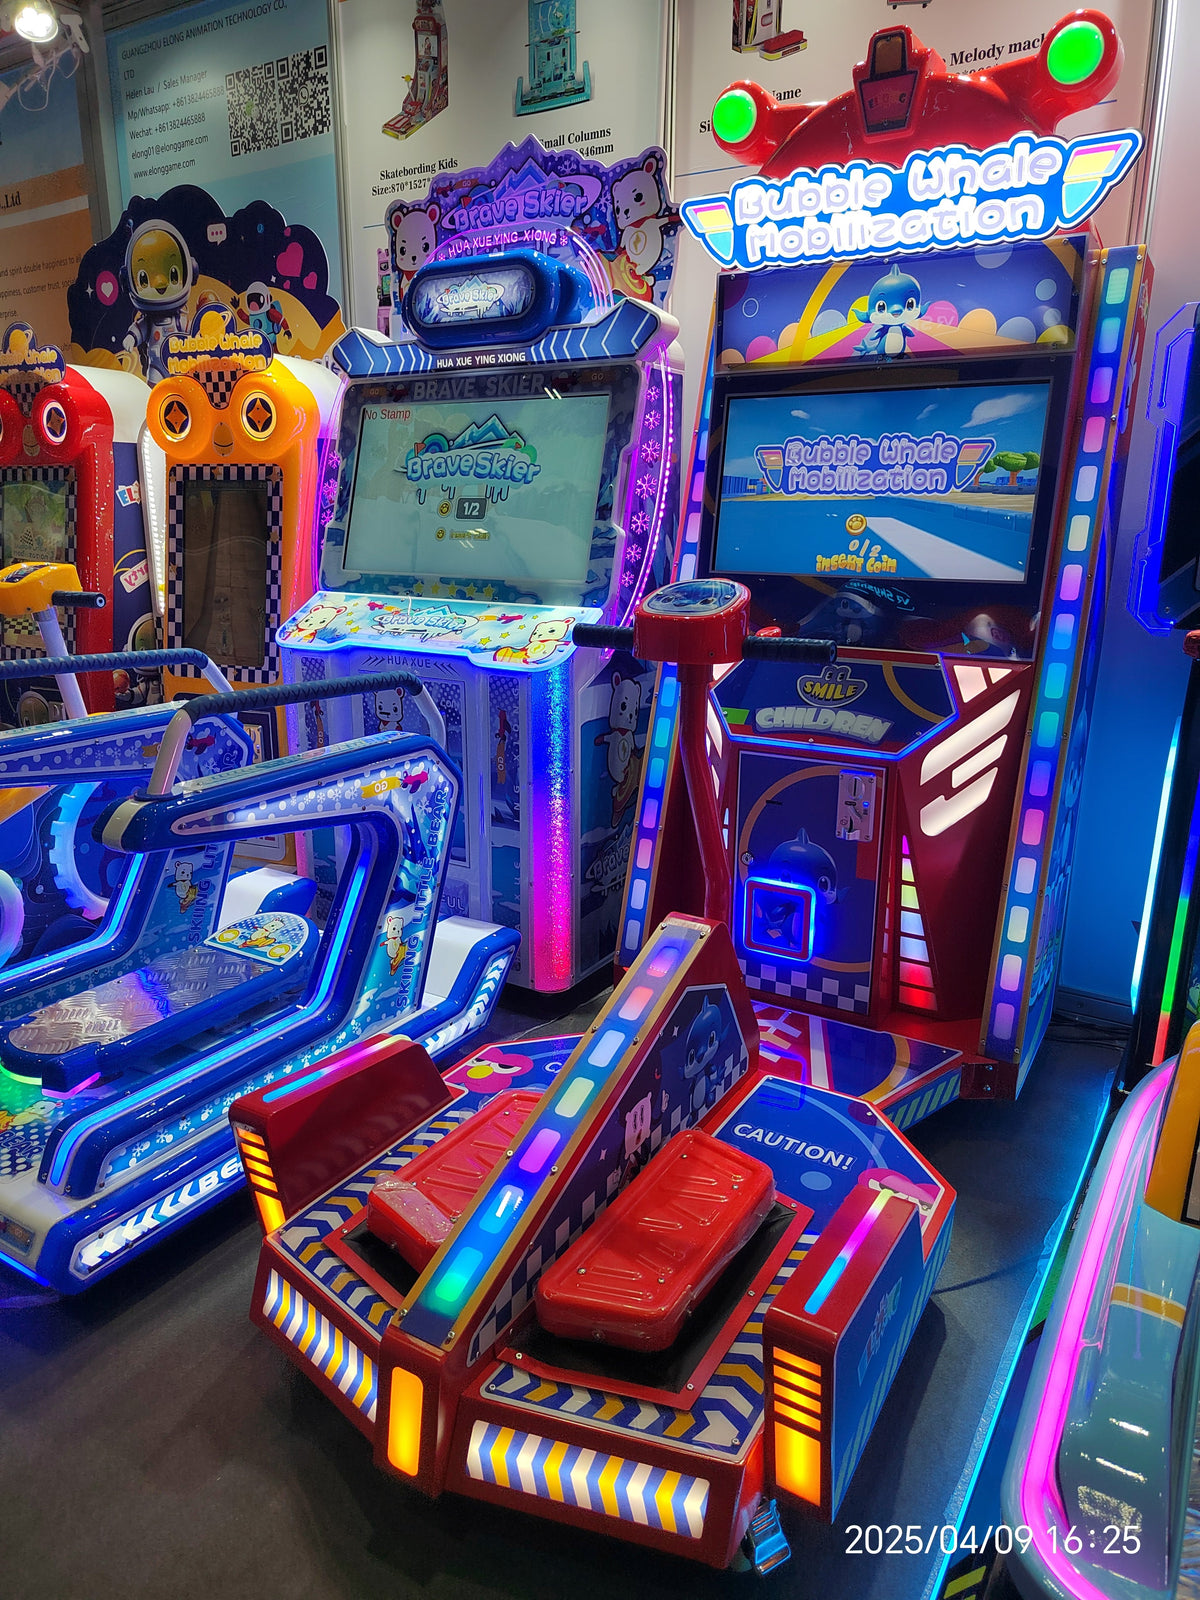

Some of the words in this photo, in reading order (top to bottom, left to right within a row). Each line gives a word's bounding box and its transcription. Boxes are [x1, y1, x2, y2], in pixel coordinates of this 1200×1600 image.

[122, 39, 162, 60] GUANGZHOU
[163, 31, 185, 47] ELONG
[185, 19, 224, 40] ANIMATION
[225, 2, 272, 27] TECHNOLOGY
[949, 43, 1006, 66] Melody
[124, 69, 135, 80] LTD
[125, 89, 143, 100] Helen
[143, 85, 155, 96] Lau
[163, 78, 180, 90] Sales
[180, 70, 208, 84] Manager
[129, 127, 152, 140] Wechat:
[155, 112, 206, 134] +8613824465888
[567, 128, 611, 144] Columns
[699, 119, 713, 134] Si
[131, 135, 209, 160] elong01@elonggame.com
[576, 143, 614, 157] 846mm
[133, 158, 196, 179] www.elonggame.com
[380, 163, 436, 181] Skatebording
[438, 158, 458, 170] Kids
[736, 168, 892, 225] Bubble
[908, 142, 1063, 200] Whale
[453, 198, 518, 232] Brave
[523, 188, 588, 219] Skier
[746, 193, 1045, 259] Mobilization
[448, 240, 471, 258] HUA
[472, 236, 492, 247] XUE
[494, 231, 518, 246] YING
[523, 229, 557, 244] XIONG
[9, 266, 22, 277] spirit
[24, 263, 41, 274] double
[42, 257, 68, 271] happiness
[69, 256, 75, 264] to
[23, 284, 47, 295] customer
[441, 289, 470, 307] Brave
[168, 334, 219, 354] Bubble
[219, 331, 263, 351] Whale
[25, 347, 58, 365] Whale
[436, 358, 454, 369] HUA
[456, 356, 472, 367] XUE
[475, 354, 496, 365] YING
[497, 352, 526, 363] XIONG
[413, 378, 477, 400] BRAVE
[486, 373, 547, 397] SKIER
[364, 409, 378, 420] No
[380, 408, 411, 421] Stamp
[785, 438, 872, 467] Bubble
[879, 436, 958, 465] Whale
[406, 452, 473, 484] Brave
[475, 450, 543, 484] Skier
[788, 465, 948, 491] Mobilization
[463, 502, 480, 516] 1/2
[379, 614, 424, 626] Brave
[386, 655, 411, 666] HUA
[411, 658, 431, 669] XUE
[803, 680, 858, 701] SMILE
[755, 706, 892, 743] CHILDREN
[396, 935, 419, 1008] SKIING
[412, 856, 435, 925] LITTLE
[427, 789, 448, 847] BEAR
[188, 880, 211, 943] SKIING
[733, 1123, 854, 1170] CAUTION!
